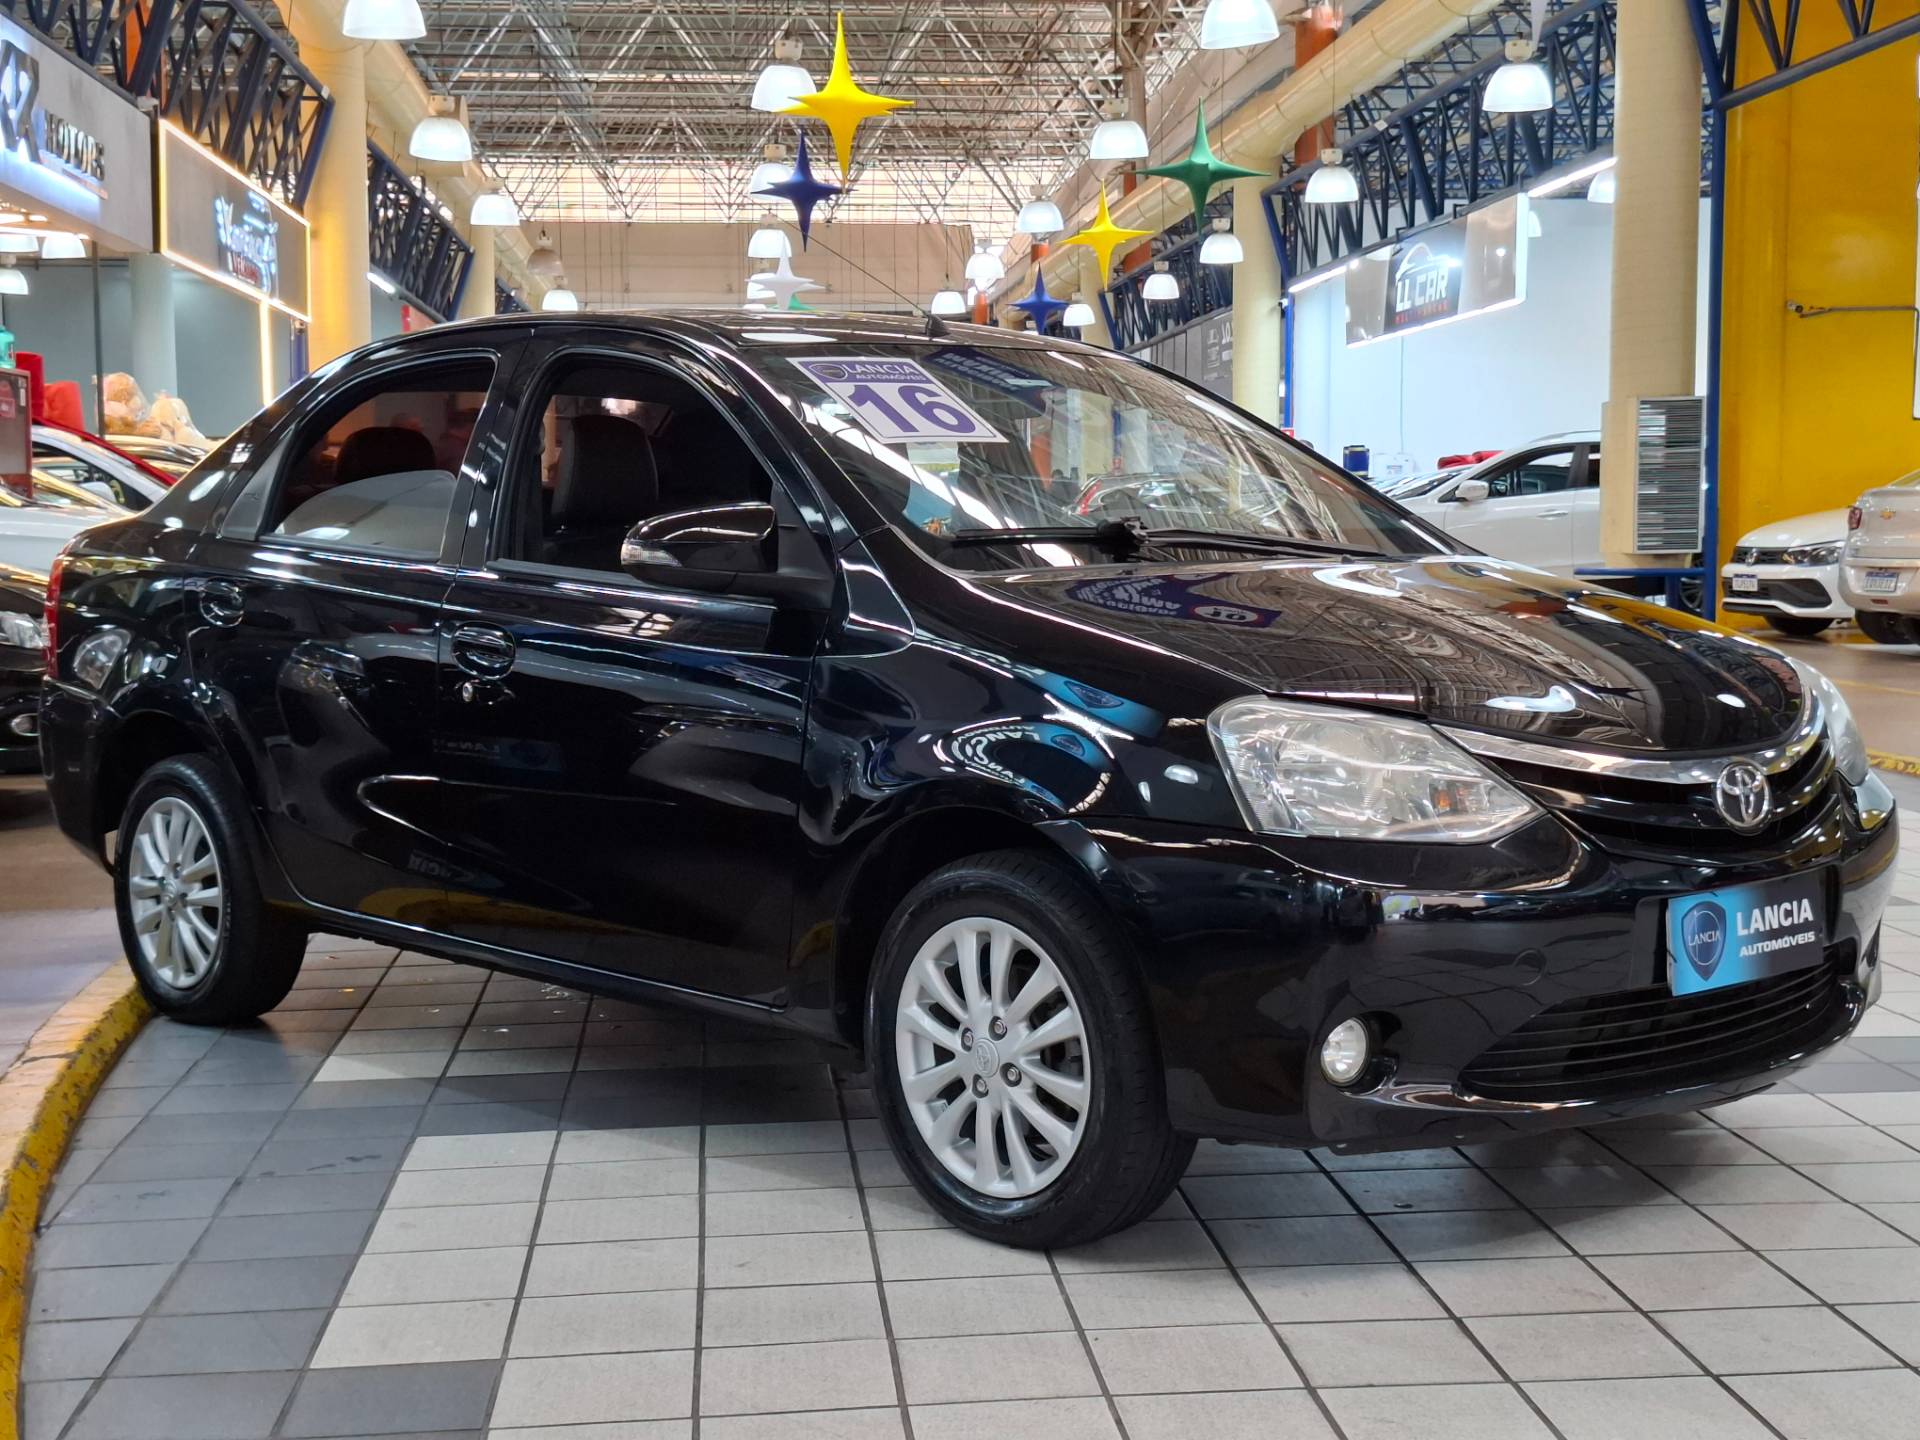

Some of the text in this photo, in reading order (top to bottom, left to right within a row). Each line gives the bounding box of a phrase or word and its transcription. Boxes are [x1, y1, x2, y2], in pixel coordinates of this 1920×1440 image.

[1414, 267, 1449, 307] CAR
[842, 364, 920, 375] LANCIA
[847, 384, 977, 433] 16
[1736, 898, 1814, 936] LANCIA
[1688, 930, 1721, 946] LANCIA
[1739, 931, 1816, 957] AUTOMÓVEIS
